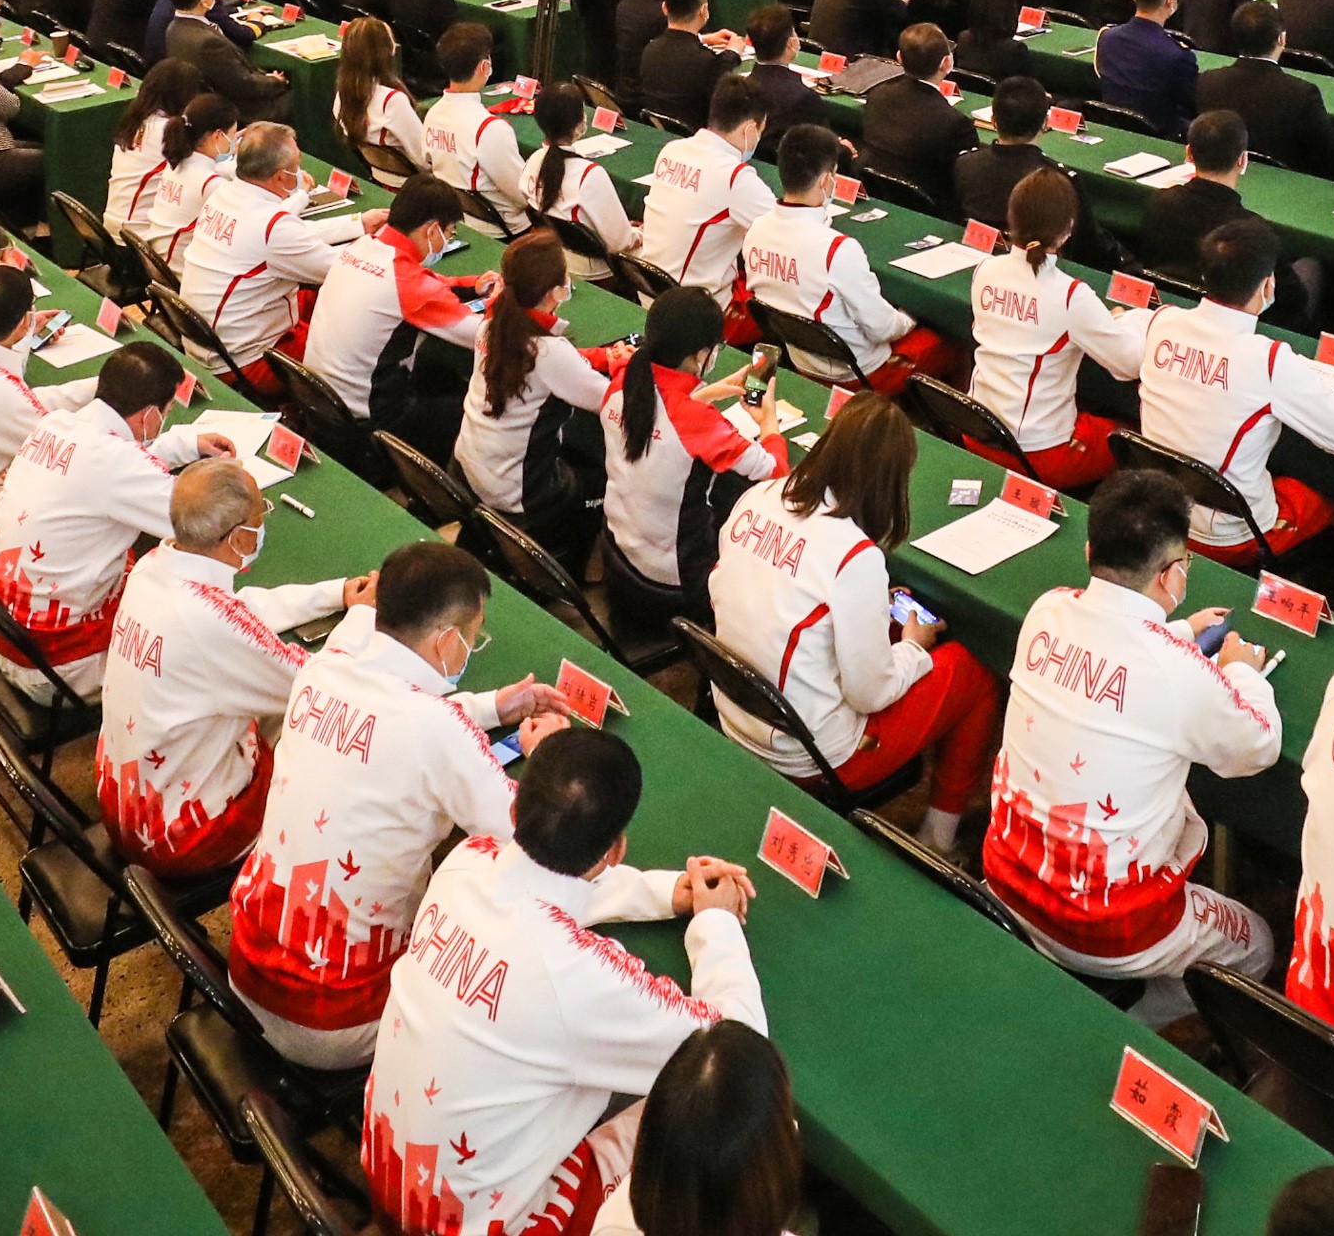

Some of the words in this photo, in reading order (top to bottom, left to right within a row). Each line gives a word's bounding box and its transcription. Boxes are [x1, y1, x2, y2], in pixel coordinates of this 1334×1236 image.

[425, 127, 457, 155] CHINA
[655, 156, 701, 194] CHINA
[361, 262, 386, 279] 2022
[748, 247, 799, 285] CHINA
[980, 285, 1040, 326] CHINA
[1153, 339, 1230, 391] CHINA
[728, 509, 807, 579] CHINA
[1025, 630, 1128, 714] CHINA
[288, 684, 377, 766] CHINA
[1190, 889, 1252, 951] CHINA
[408, 902, 509, 1022] CHINA
